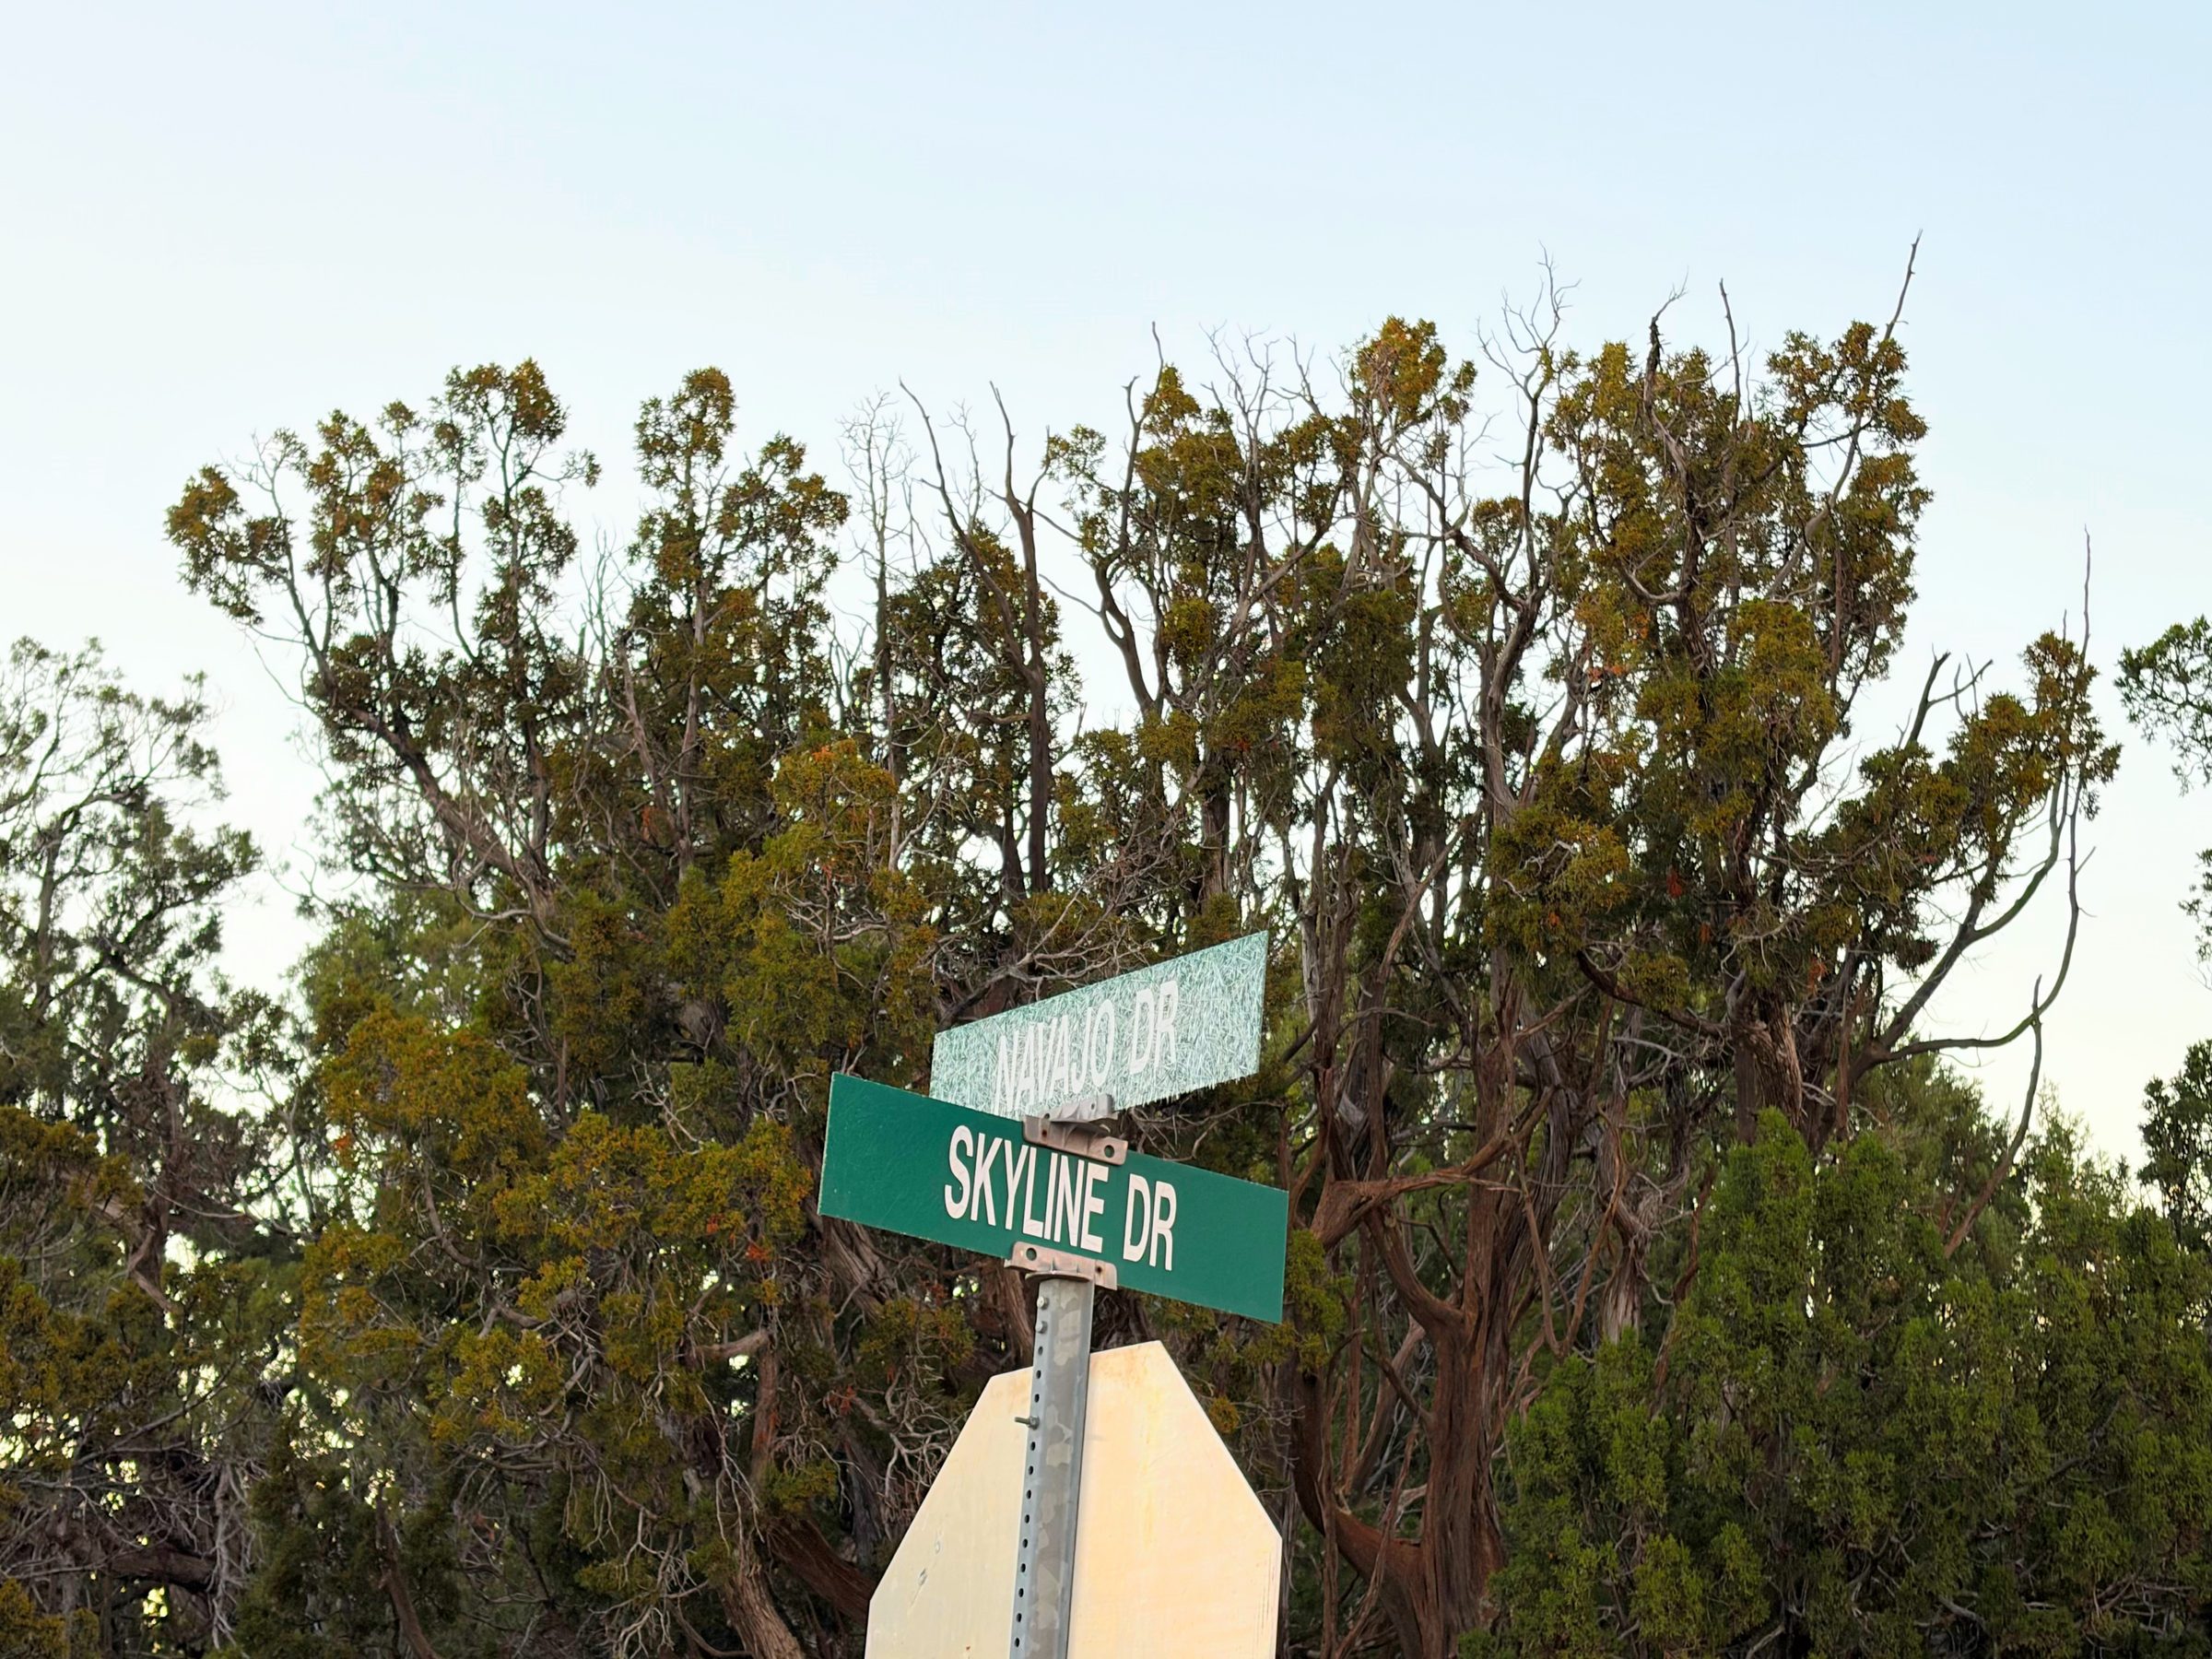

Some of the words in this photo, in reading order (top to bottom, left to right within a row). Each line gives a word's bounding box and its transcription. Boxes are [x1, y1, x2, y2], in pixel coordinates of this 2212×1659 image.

[994, 999, 1116, 1113] NAVAJO
[1128, 980, 1180, 1076] DR
[944, 1124, 1110, 1253] SKYLINE
[1122, 1172, 1177, 1272] DR
